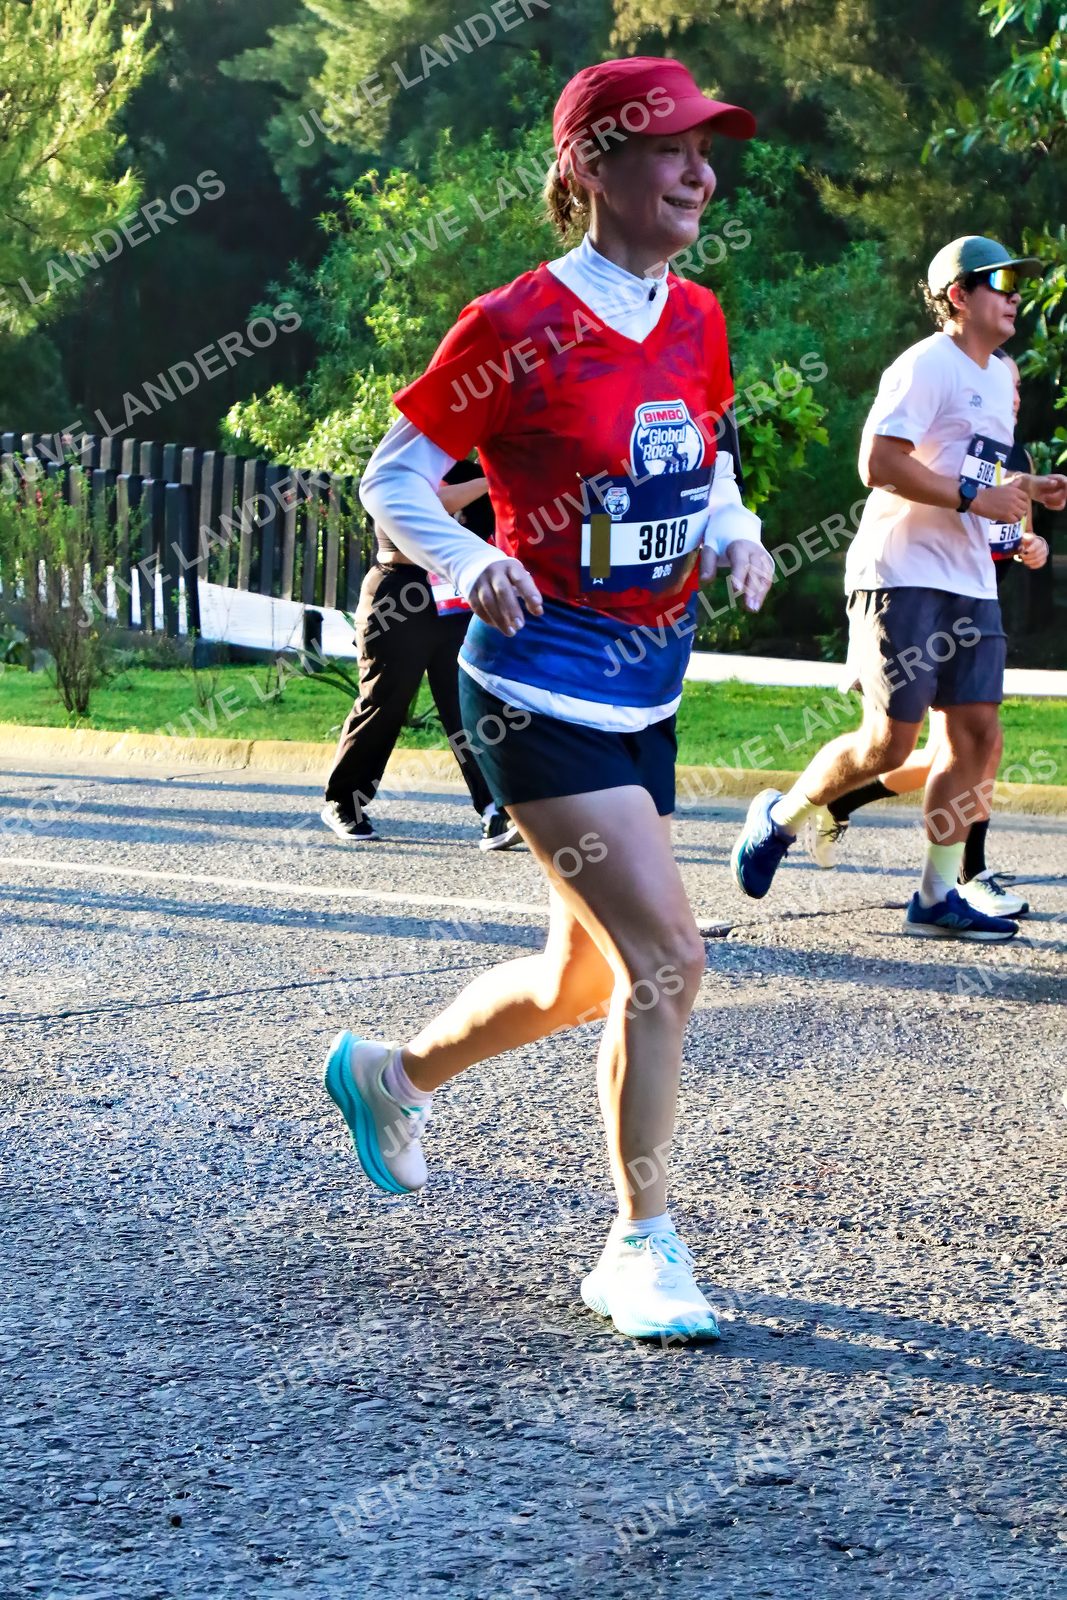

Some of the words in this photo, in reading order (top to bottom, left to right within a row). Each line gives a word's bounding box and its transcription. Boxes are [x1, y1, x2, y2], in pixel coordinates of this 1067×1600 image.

[644, 409, 684, 424] BIMBO
[649, 427, 685, 445] Global
[643, 443, 674, 461] Race
[639, 518, 688, 561] 3818
